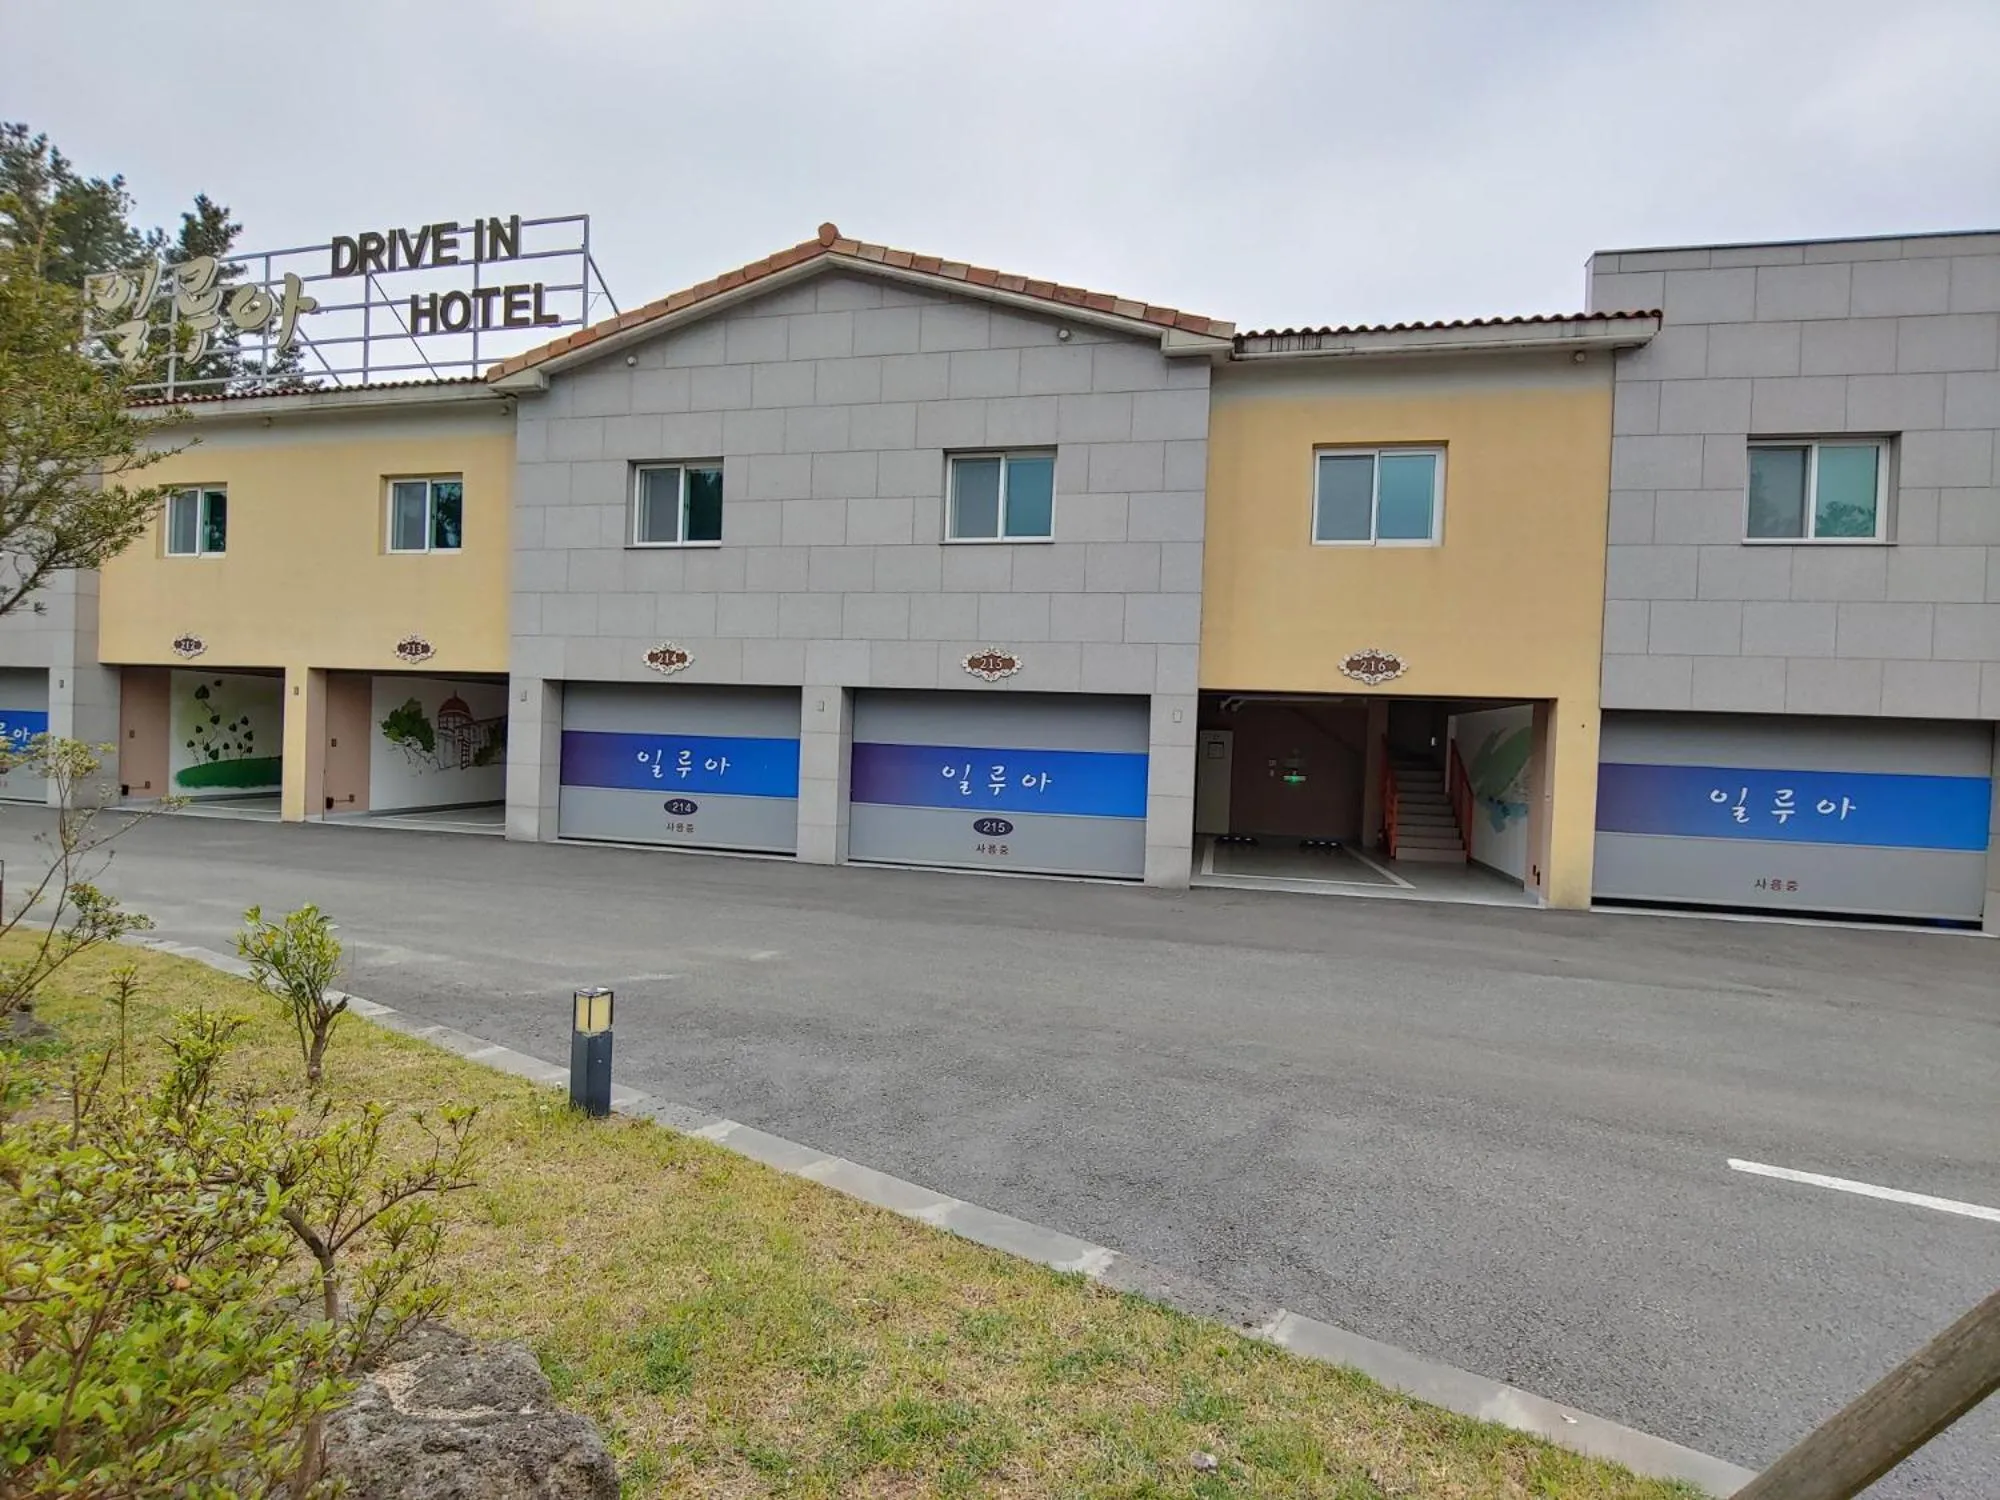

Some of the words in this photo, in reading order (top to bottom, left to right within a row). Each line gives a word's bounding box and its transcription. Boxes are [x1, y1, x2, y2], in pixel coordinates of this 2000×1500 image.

[331, 222, 458, 277] DRIVE
[475, 214, 520, 263] IN
[411, 283, 559, 333] HOTEL
[405, 644, 422, 654] 213
[657, 653, 677, 664] 214
[980, 658, 1003, 669] 215
[1360, 660, 1386, 671] 216
[671, 801, 692, 813] 214
[982, 821, 1006, 833] 215
[1754, 877, 1799, 893] 사용중
